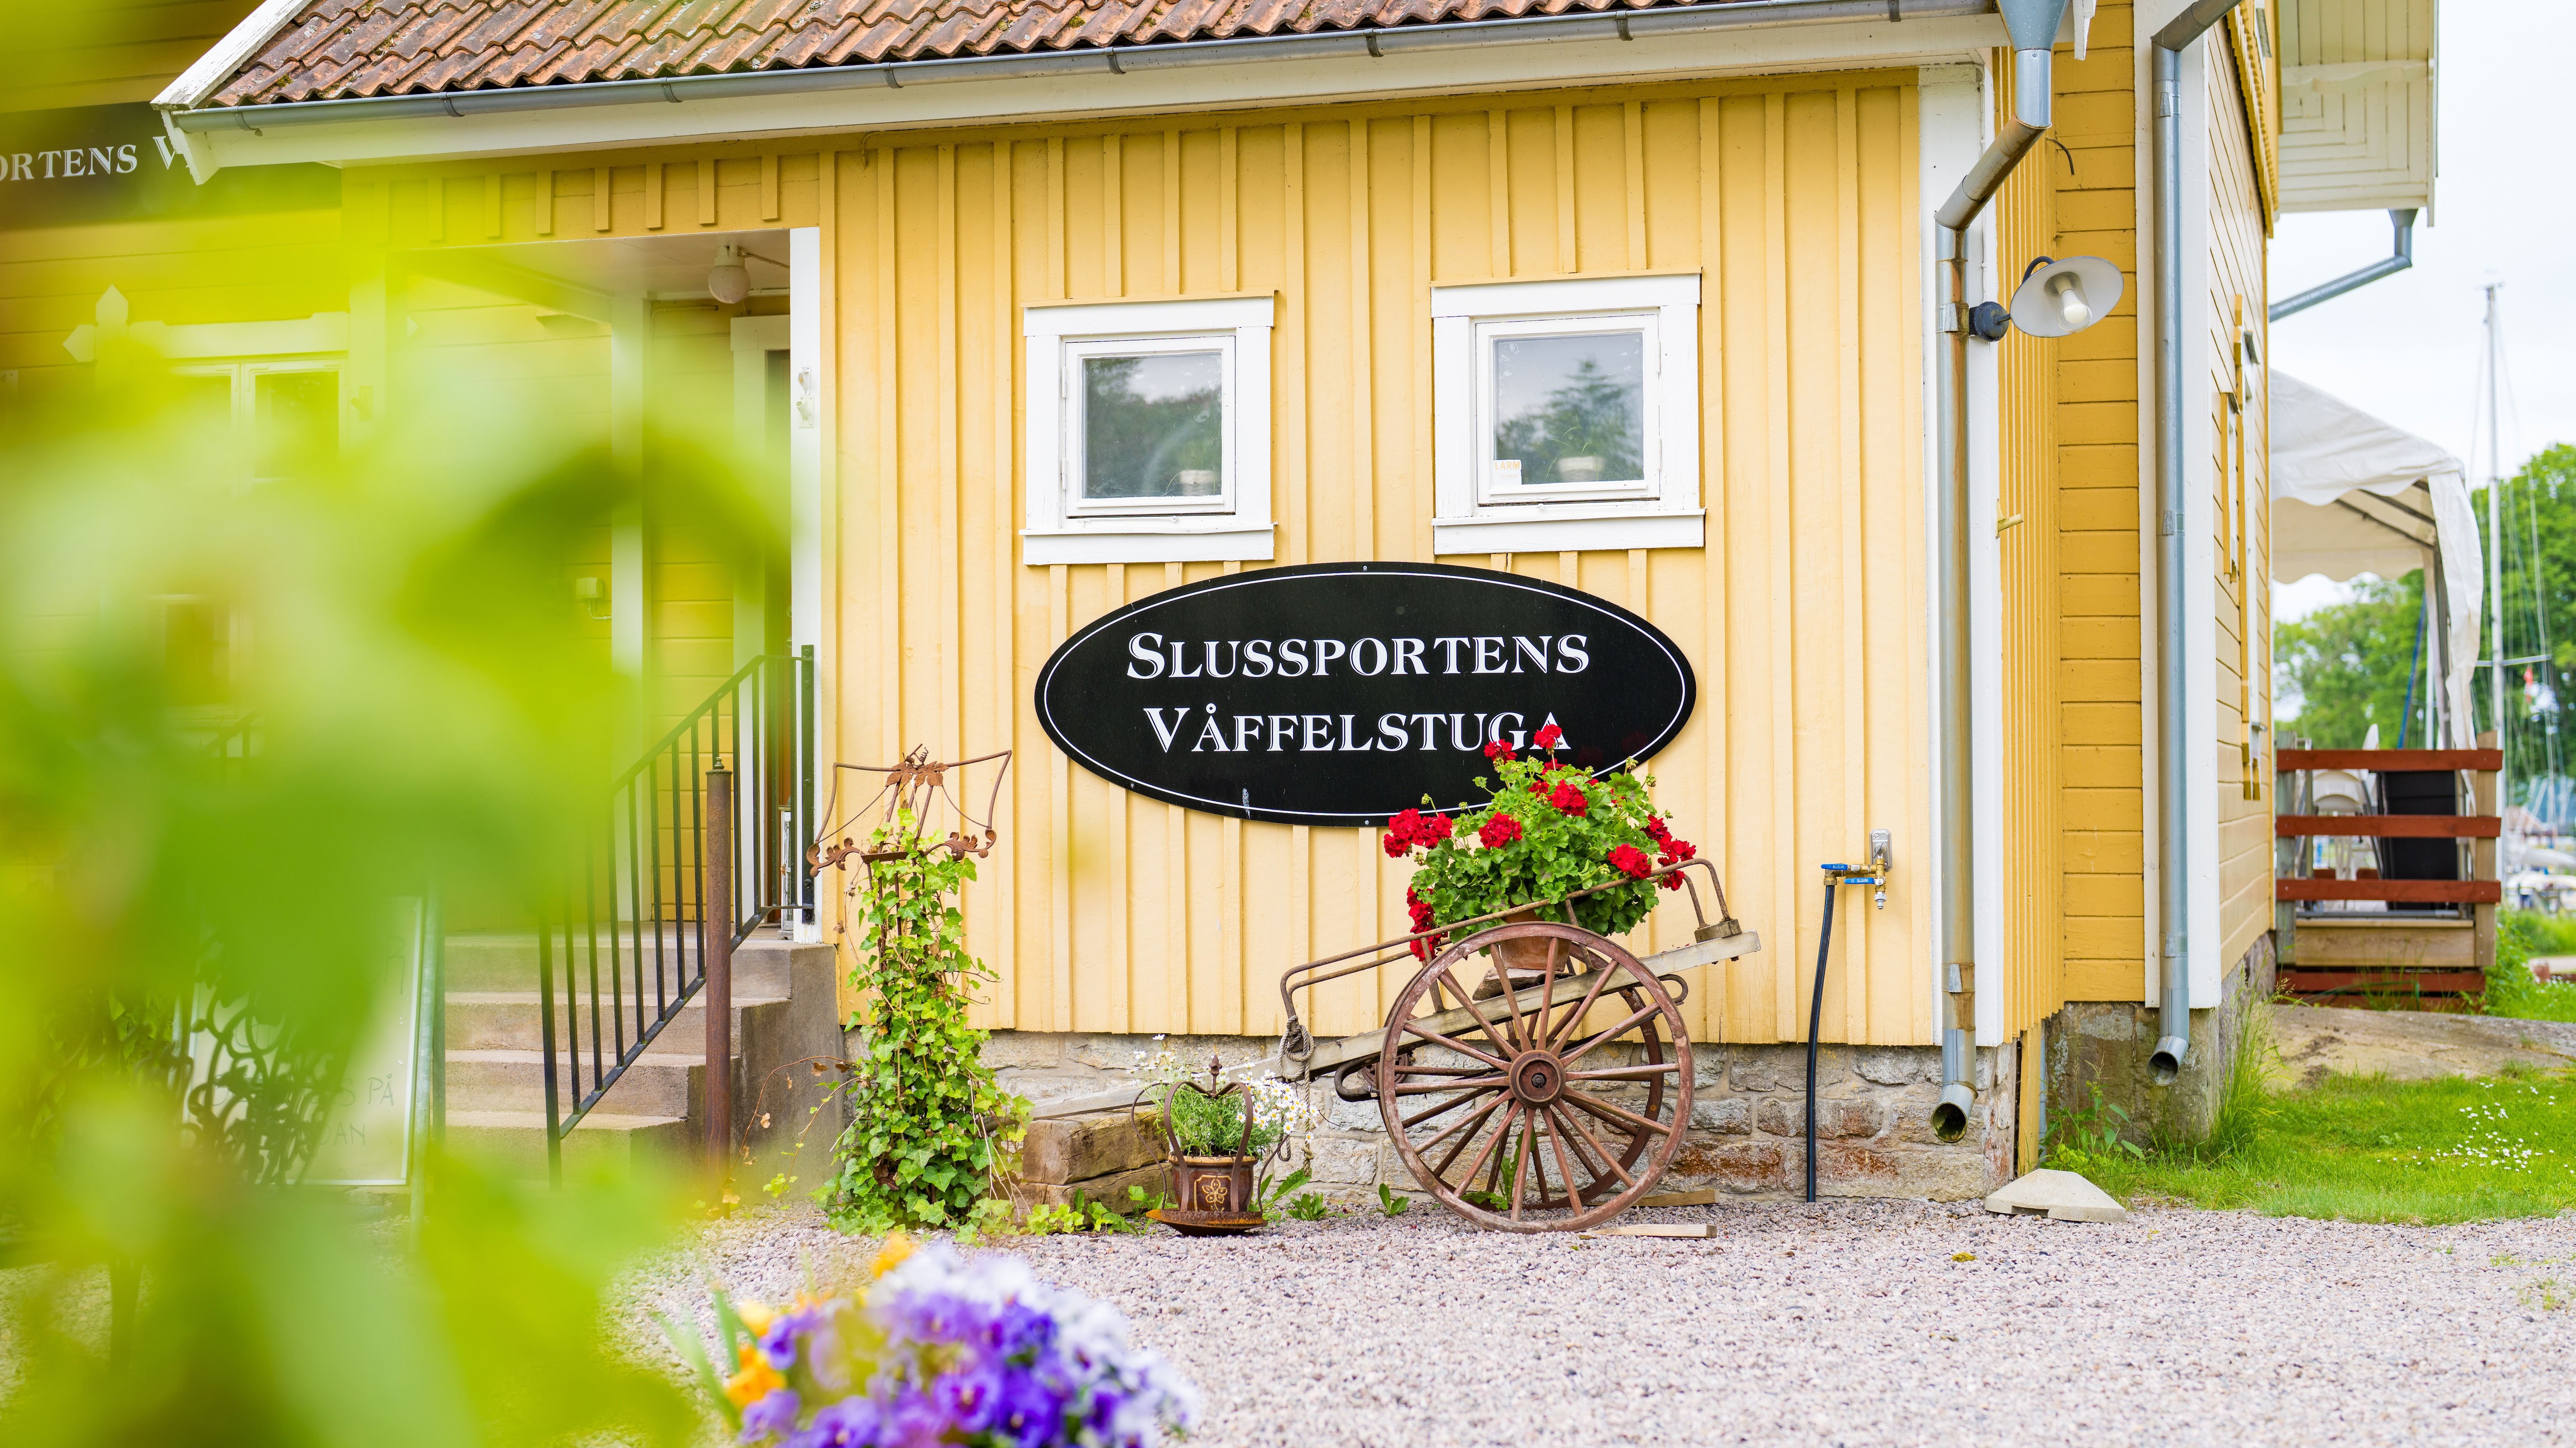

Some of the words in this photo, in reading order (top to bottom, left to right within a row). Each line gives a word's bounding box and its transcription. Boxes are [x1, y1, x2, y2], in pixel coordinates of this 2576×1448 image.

[1495, 461, 1520, 470] LARM
[1127, 632, 1589, 679] SLUSSPORTENS
[1144, 703, 1571, 753] VÅFFELSTUGA
[368, 1073, 394, 1106] PÅ
